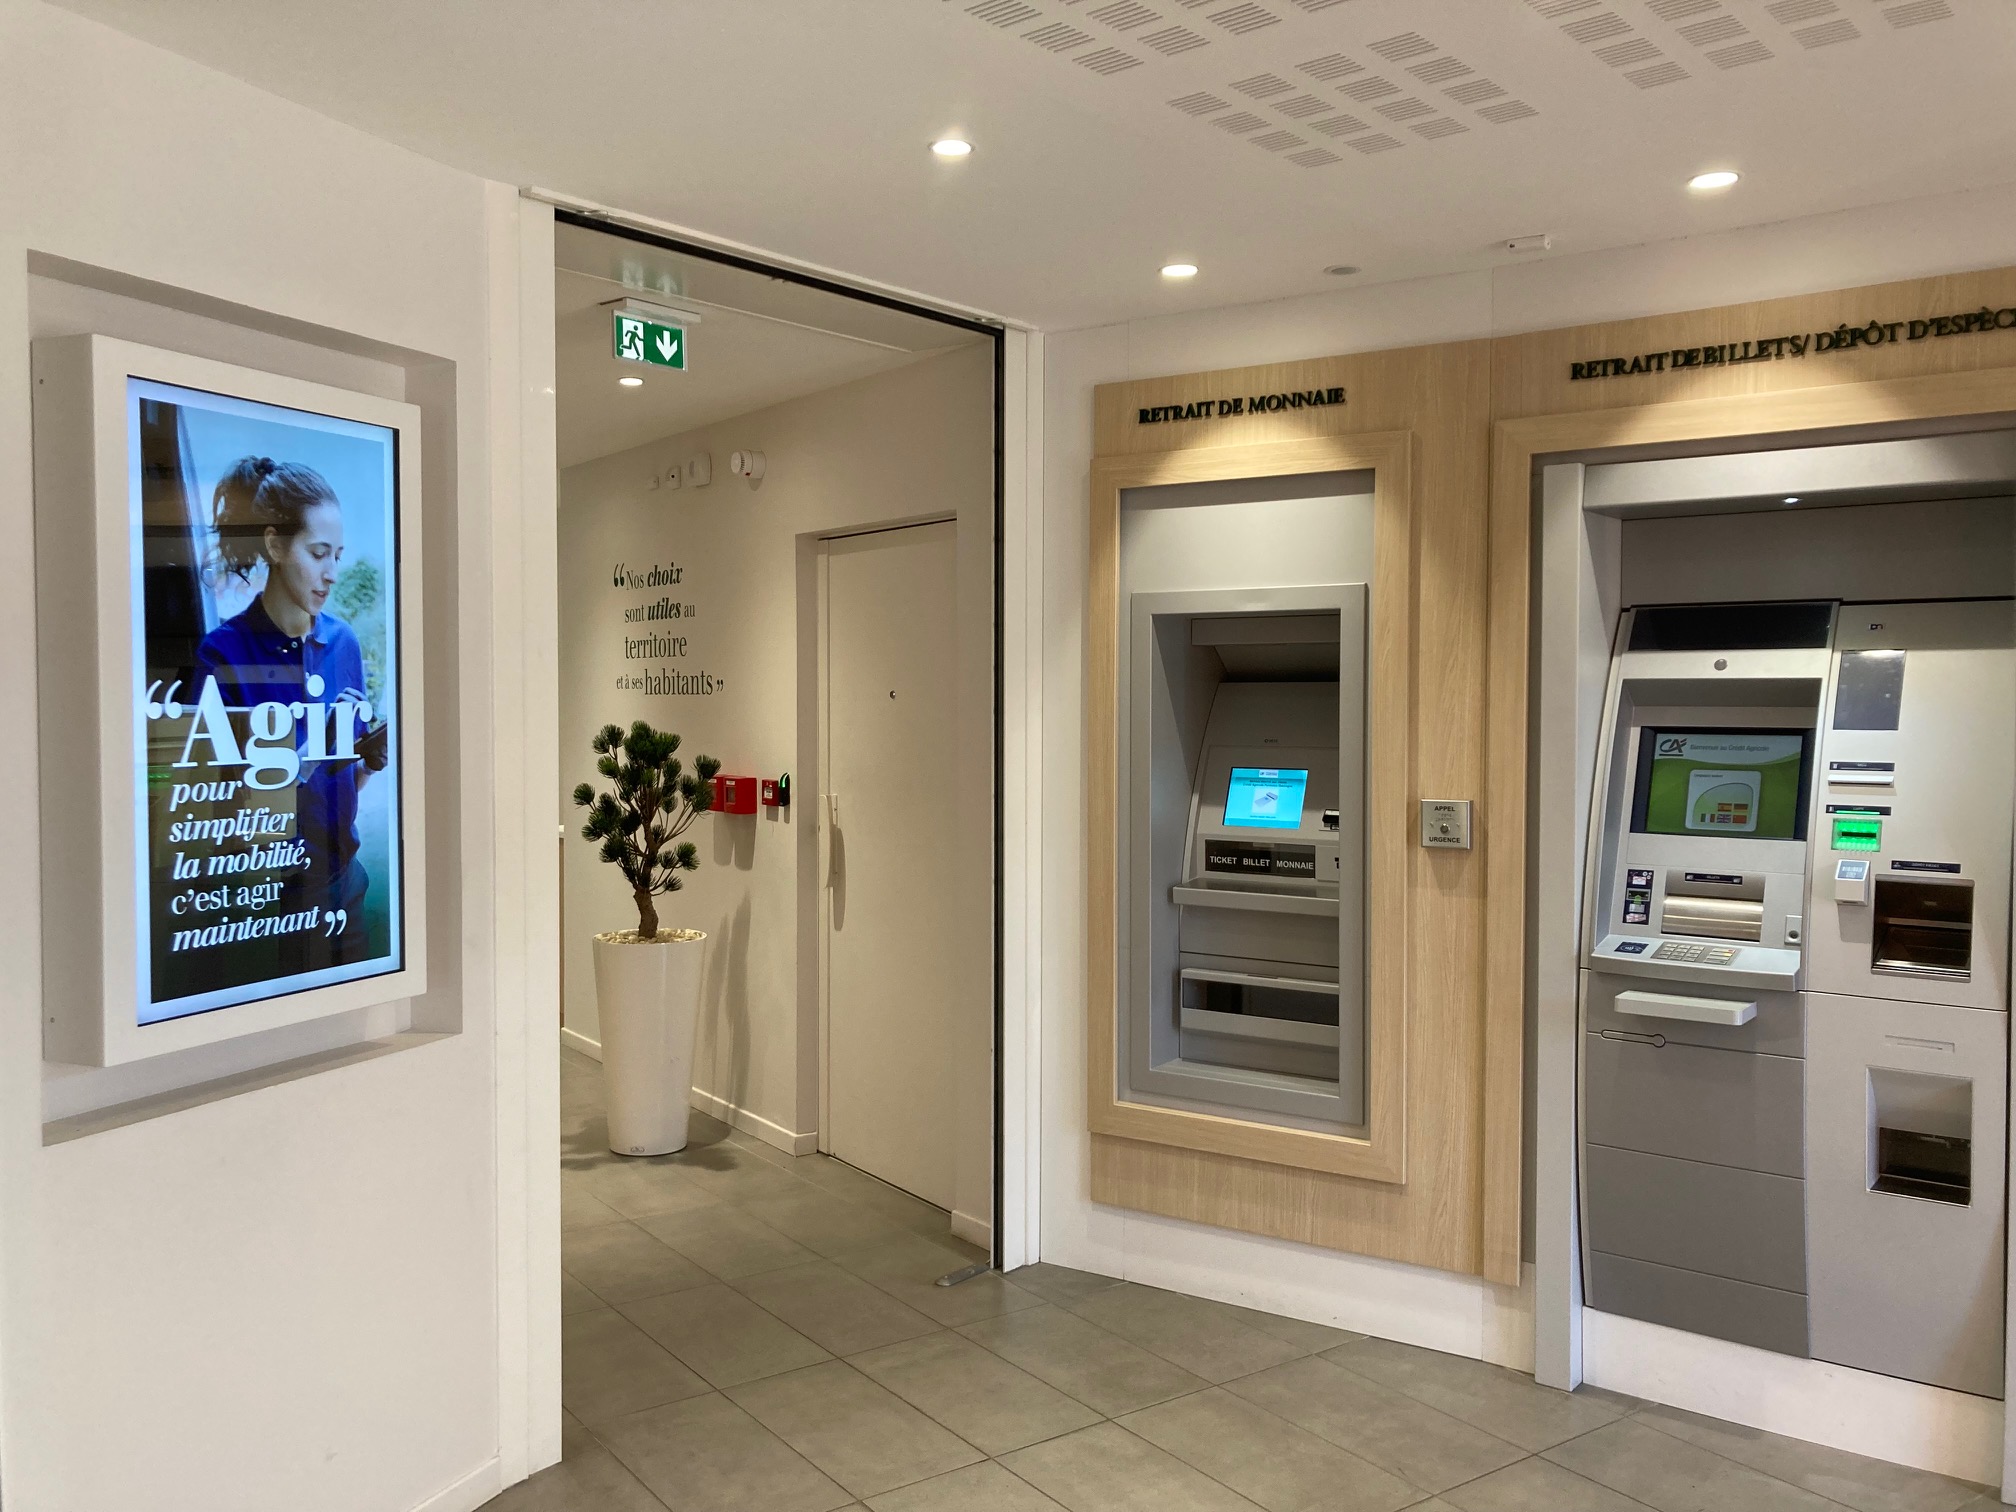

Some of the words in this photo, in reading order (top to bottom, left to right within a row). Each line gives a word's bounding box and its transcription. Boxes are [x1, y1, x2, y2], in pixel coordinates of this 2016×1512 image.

[1570, 351, 1670, 380] RETRAIT
[1671, 348, 1702, 369] DE
[1814, 319, 1904, 352] DÉPÔT
[1907, 305, 2016, 341] D'ESPÈC
[1138, 400, 1216, 424] RETRAIT
[1218, 398, 1244, 416] DE
[1247, 387, 1346, 413] MONNAIE
[647, 561, 683, 588] choix
[624, 603, 645, 623] sont
[647, 597, 682, 621] utiles
[683, 604, 696, 618] au
[624, 630, 688, 659] territoire
[616, 675, 624, 690] et
[624, 674, 630, 690] à
[631, 675, 644, 690] ses
[644, 667, 714, 696] habitants
[169, 778, 243, 812] pour
[168, 806, 296, 846] simplifier
[1428, 836, 1461, 844] URGENCE
[172, 852, 201, 880] la
[207, 839, 312, 876] mobilité,
[1209, 855, 1237, 865] TICKET
[1242, 857, 1271, 867] BILLET
[1276, 860, 1314, 870] MONNAIE
[236, 876, 284, 910] agir
[172, 906, 320, 952] maintenant
